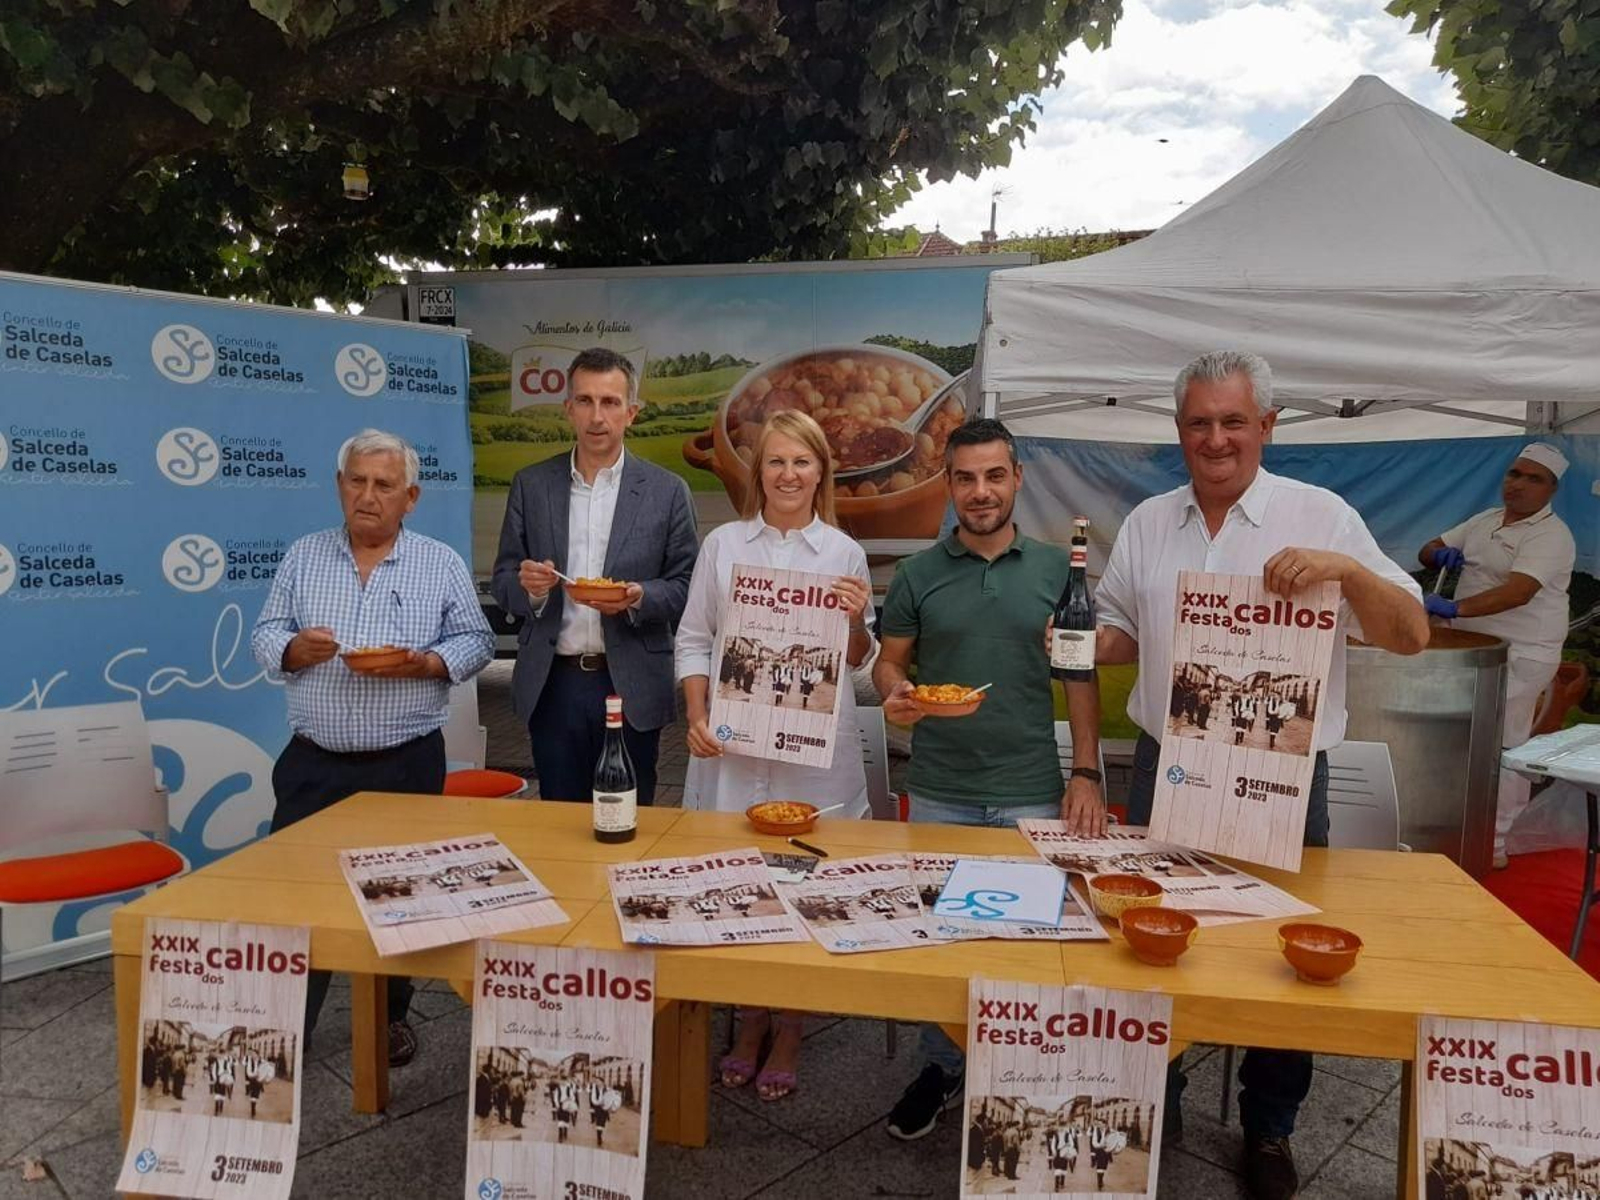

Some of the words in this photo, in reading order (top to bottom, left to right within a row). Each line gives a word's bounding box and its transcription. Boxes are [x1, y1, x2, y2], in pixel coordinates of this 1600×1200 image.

[421, 290, 452, 303] FRCX
[3, 311, 62, 329] Concello
[65, 319, 81, 330] de
[523, 320, 580, 335] Alimentos
[583, 321, 594, 333] de
[5, 325, 83, 347] Salceda
[217, 334, 264, 350] Concello
[266, 341, 278, 350] de
[6, 345, 30, 360] de
[36, 347, 113, 367] Caselas
[218, 347, 280, 365] Salceda
[426, 357, 437, 366] de
[218, 364, 238, 377] de
[242, 365, 304, 382] Caselas
[388, 363, 438, 379] Salceda
[388, 379, 404, 391] de
[407, 380, 457, 396] Caselas
[519, 368, 565, 396] CO
[10, 425, 67, 439] Concello
[71, 428, 86, 439] de
[221, 435, 267, 447] Concello
[269, 438, 282, 447] de
[11, 438, 88, 456] Salceda
[222, 447, 284, 462] Salceda
[12, 457, 36, 472] de
[42, 458, 117, 474] Caselas
[222, 463, 242, 477] de
[246, 464, 306, 479] Caselas
[418, 469, 457, 481] aselas
[17, 543, 74, 554] Concello
[78, 543, 92, 553] de
[226, 539, 271, 549] Concello
[20, 554, 95, 571] Salceda
[20, 573, 43, 589] de
[49, 571, 124, 587] Caselas
[227, 567, 247, 581] de
[736, 576, 774, 591] XXIX
[733, 590, 775, 608] festa
[1182, 592, 1229, 609] XXIX
[772, 605, 789, 615] dos
[1180, 608, 1233, 628] festa
[1234, 601, 1335, 630] callos
[1230, 625, 1252, 636] dos
[775, 732, 786, 750] 3
[786, 733, 826, 748] SETEMBRO
[1235, 776, 1248, 798] 3
[1249, 779, 1299, 798] SETEMBRO
[1248, 792, 1267, 803] 2023
[350, 851, 397, 862] XXIX
[405, 840, 500, 859] callos
[615, 866, 661, 875] XXIX
[669, 857, 763, 875] callos
[152, 935, 200, 953] XXIX
[150, 954, 204, 976] festa
[206, 942, 307, 975] callos
[484, 958, 536, 978] XXIX
[201, 973, 224, 985] dos
[542, 968, 652, 1002] callos
[482, 978, 541, 1000] festa
[538, 999, 563, 1011] dos
[978, 999, 1038, 1021] XXIX
[977, 1023, 1043, 1046] festa
[1046, 1008, 1168, 1045] callos
[1040, 1043, 1066, 1054] dos
[1428, 1036, 1496, 1060] XXIX
[1427, 1060, 1504, 1087] festa
[1506, 1049, 1600, 1087] call
[1502, 1084, 1535, 1099] dos
[211, 1156, 227, 1181] 3
[227, 1157, 283, 1175] SETEMBRO
[224, 1173, 247, 1185] 2023
[565, 1181, 578, 1200] 3
